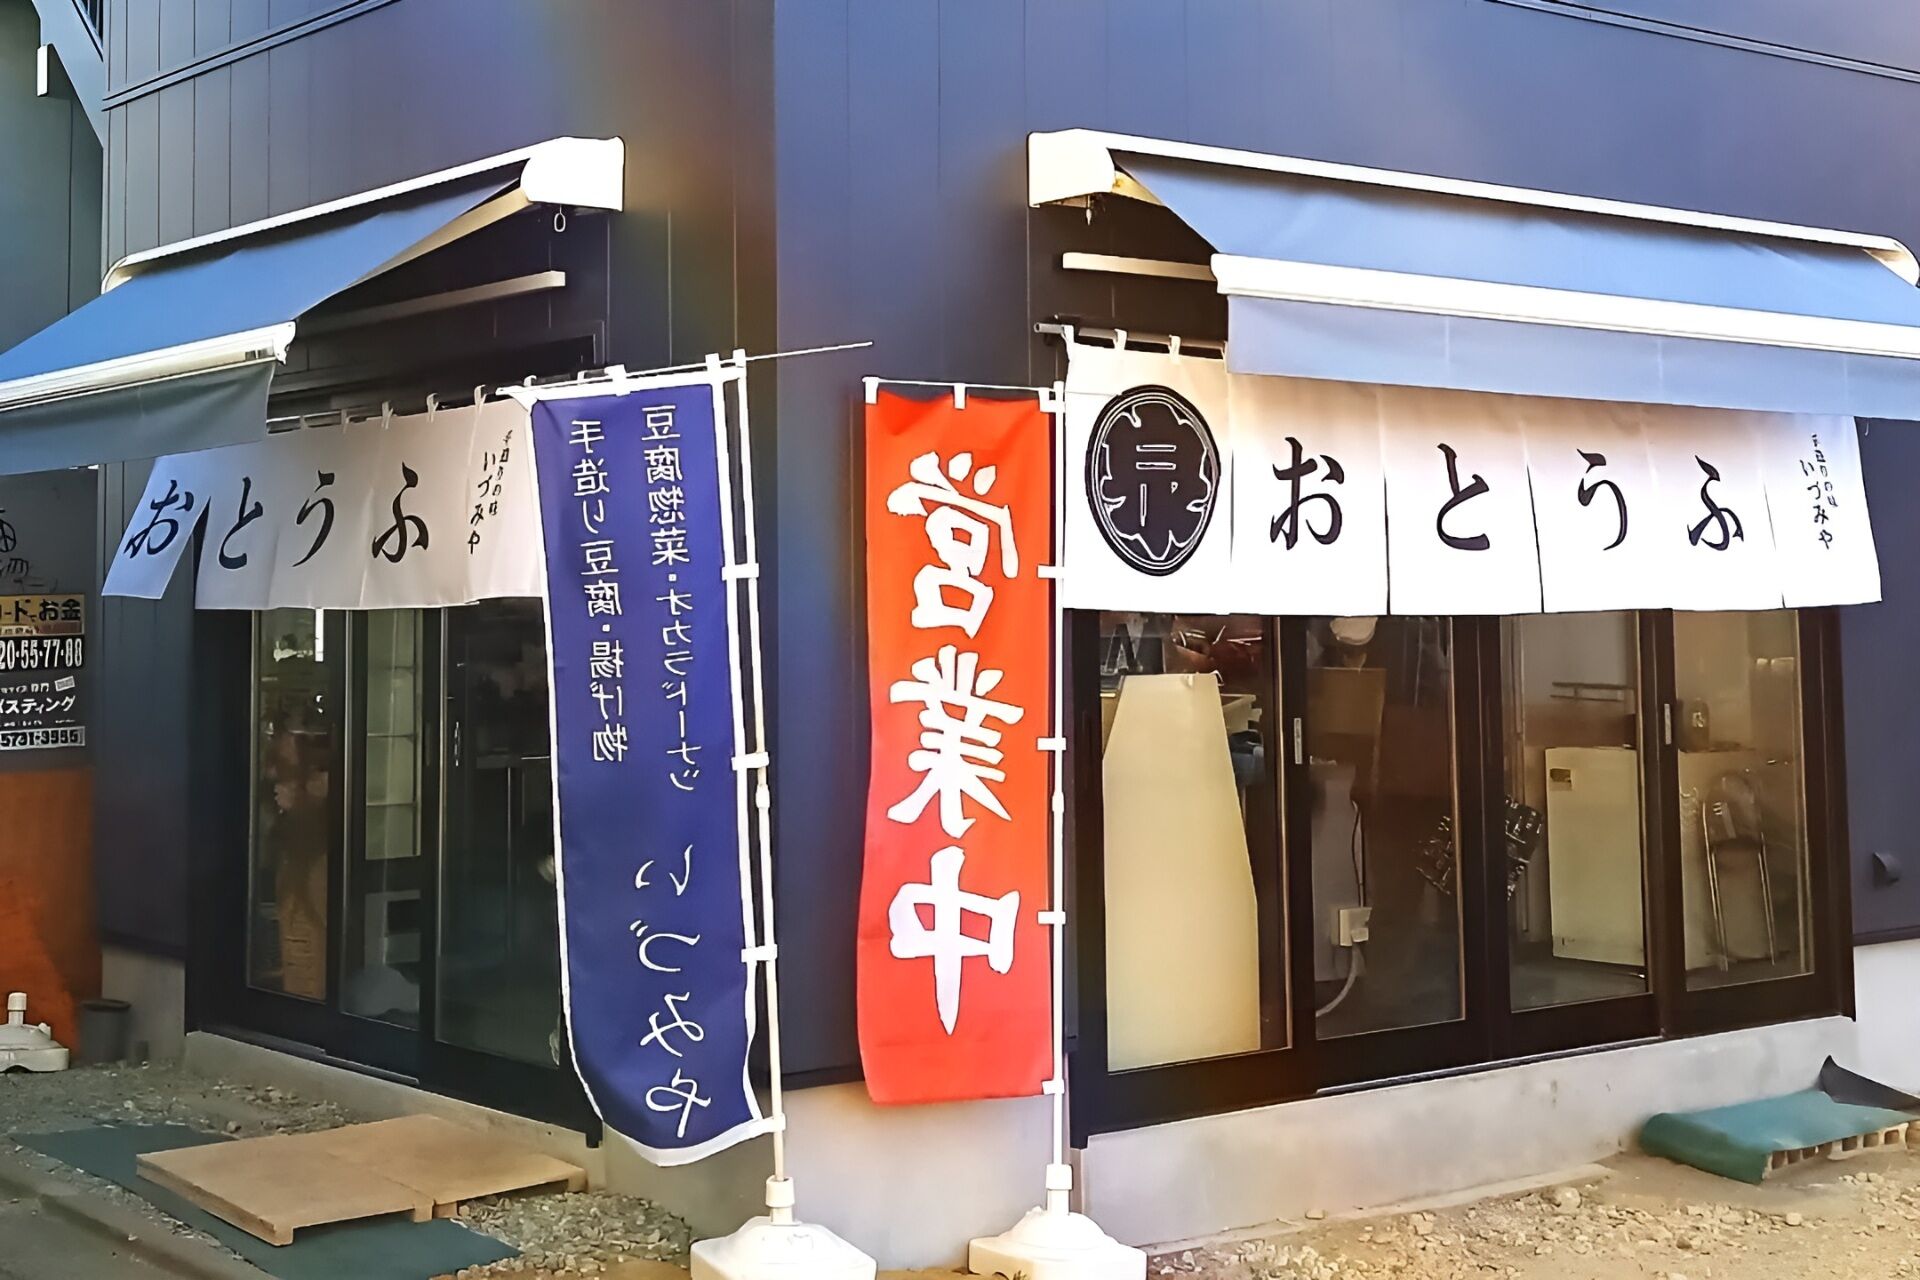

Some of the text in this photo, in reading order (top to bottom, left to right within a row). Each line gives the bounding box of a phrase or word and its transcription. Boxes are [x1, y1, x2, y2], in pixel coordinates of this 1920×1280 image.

[124, 461, 430, 570] おとうふ
[1269, 436, 1745, 552] おとうふ
[0, 598, 81, 622] ードでお金
[886, 450, 1025, 1035] 営業中
